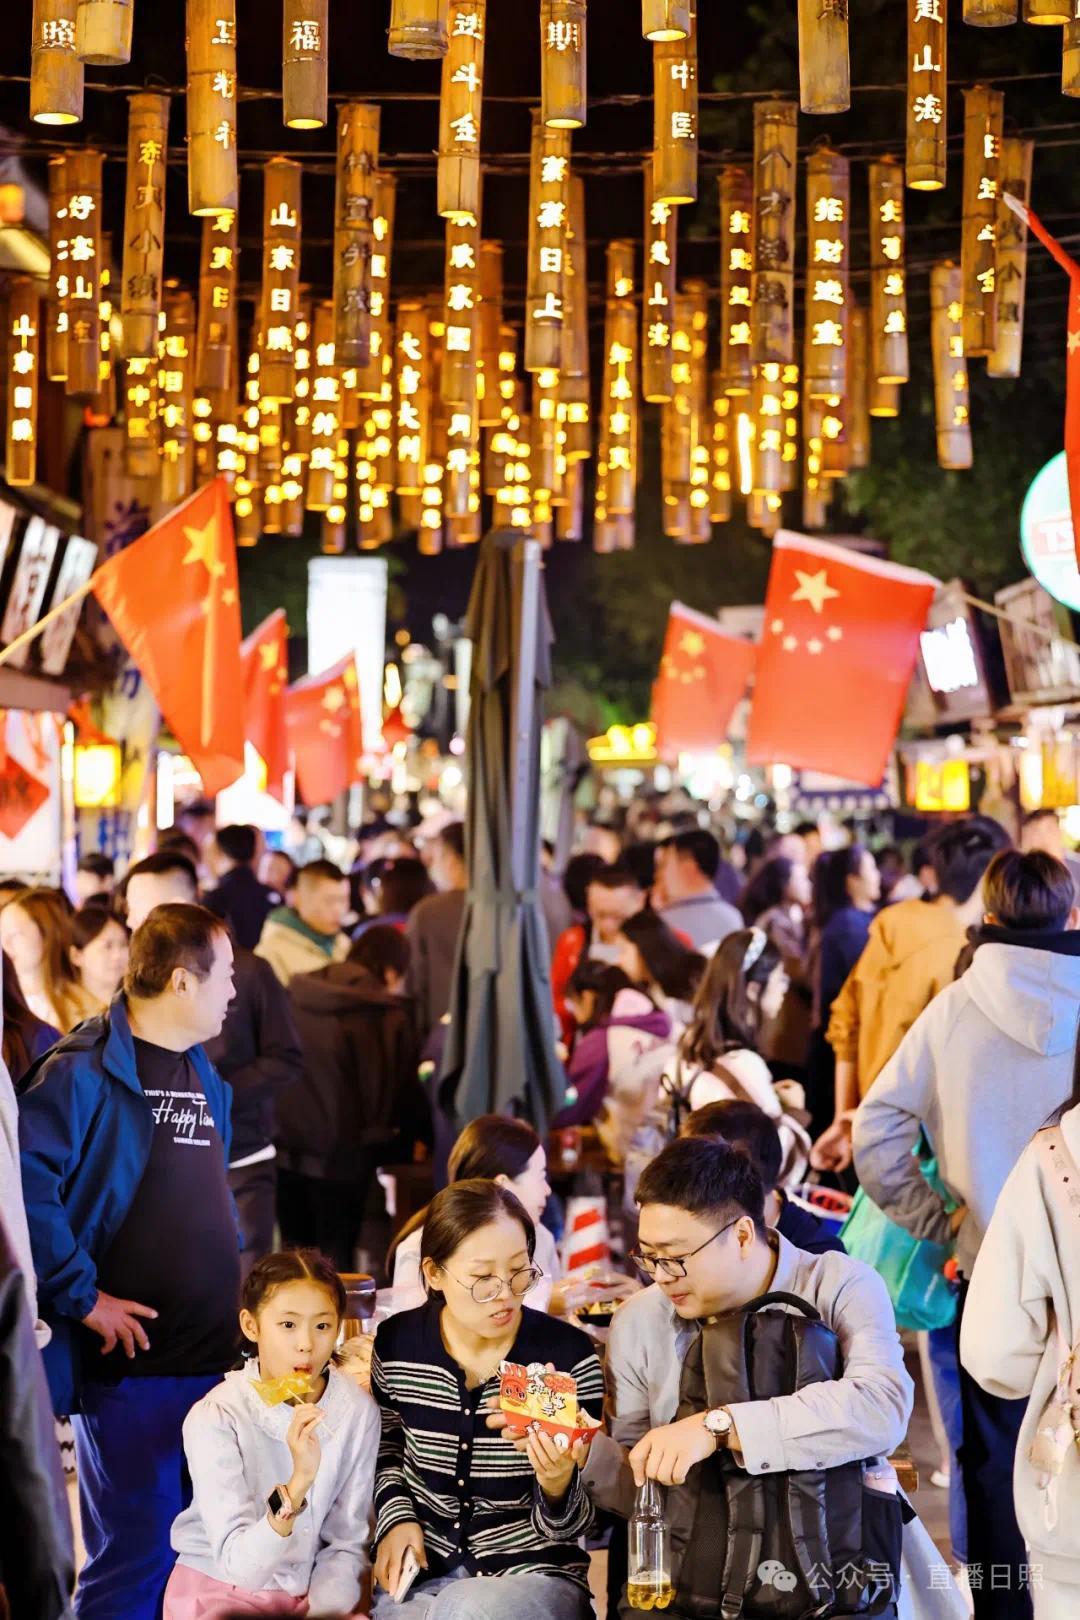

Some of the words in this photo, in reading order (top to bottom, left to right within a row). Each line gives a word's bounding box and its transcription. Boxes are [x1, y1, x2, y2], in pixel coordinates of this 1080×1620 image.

[291, 20, 321, 51] 福
[547, 21, 579, 51] 期
[152, 1098, 197, 1138] Happy
[192, 1099, 215, 1128] Tim
